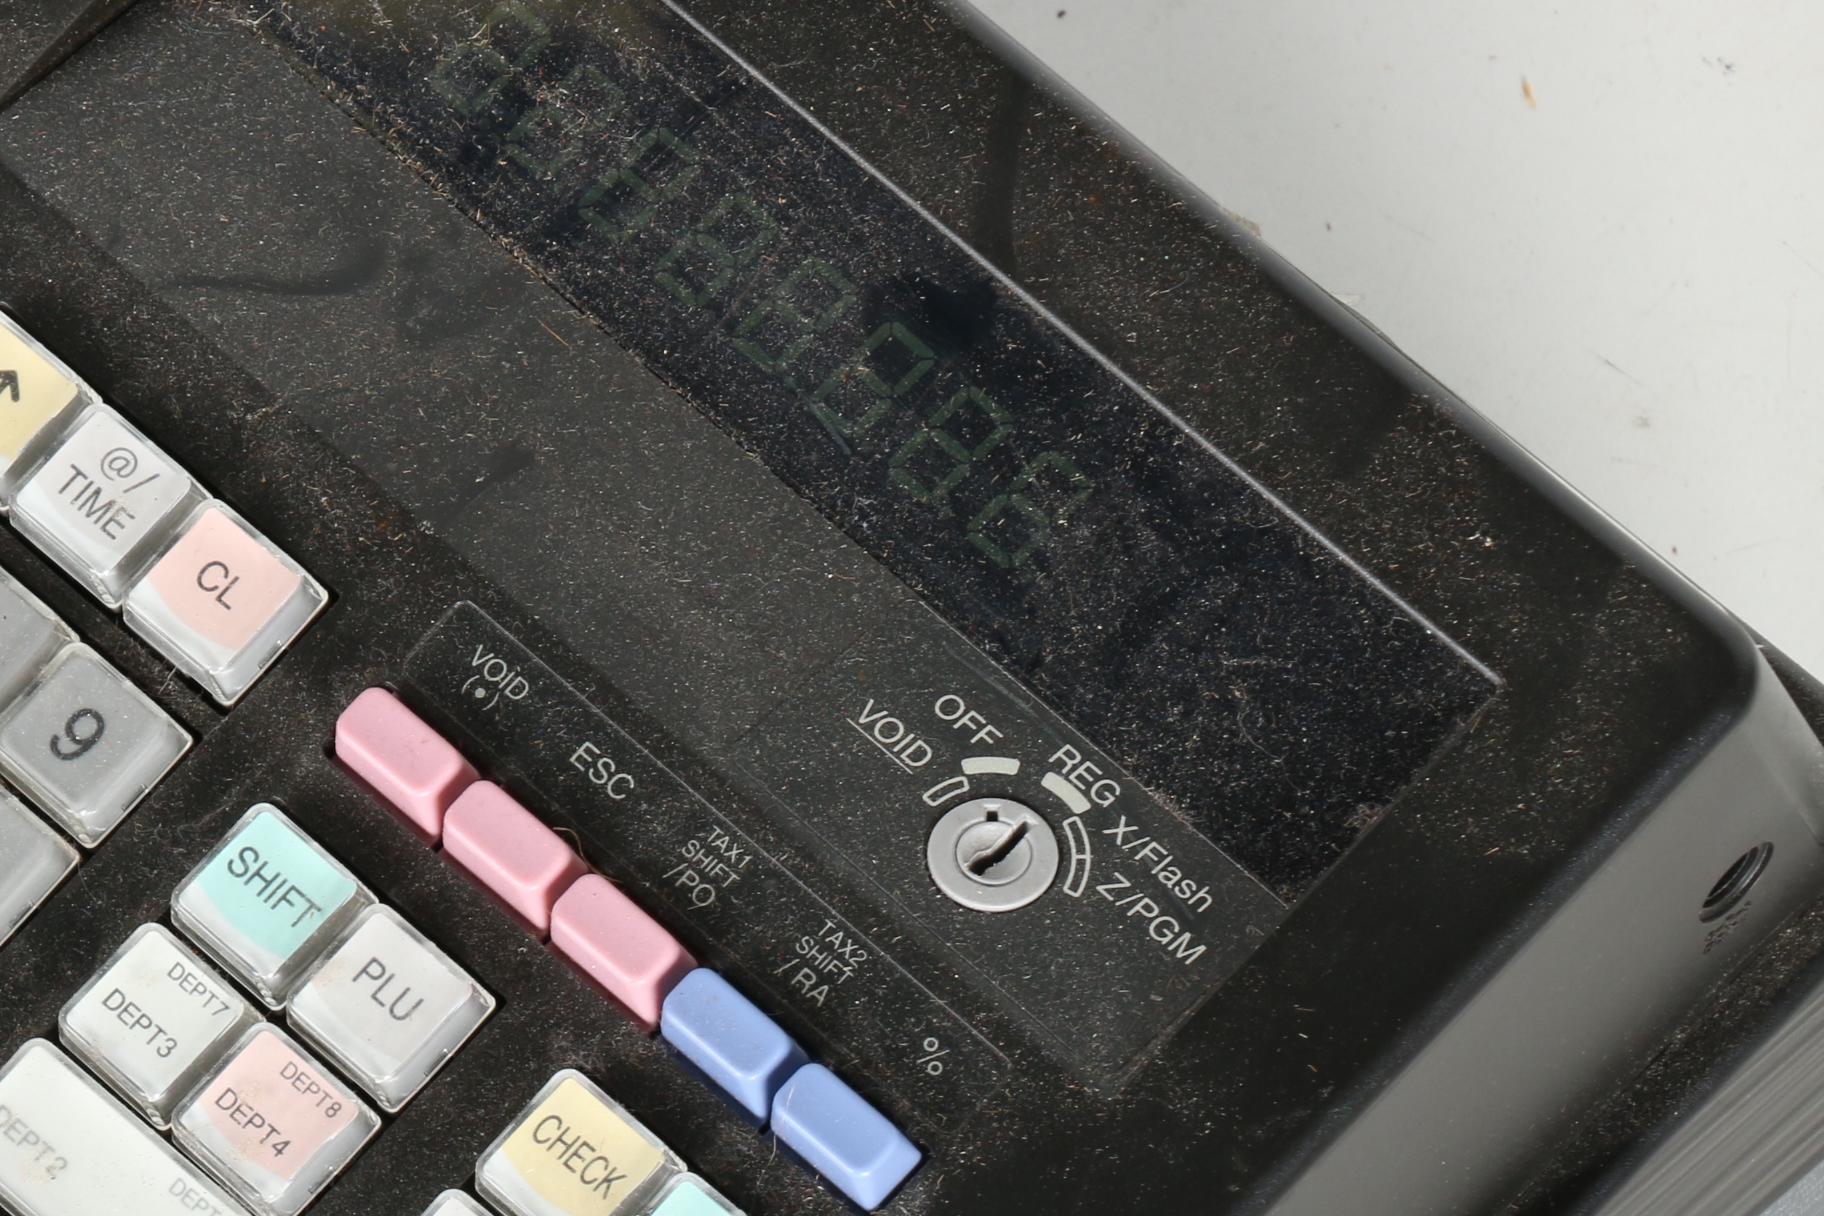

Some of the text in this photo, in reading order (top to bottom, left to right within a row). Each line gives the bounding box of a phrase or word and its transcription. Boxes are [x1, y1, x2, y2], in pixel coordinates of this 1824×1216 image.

[56, 464, 136, 541] TIME
[195, 560, 246, 612] CL
[469, 643, 530, 702] VOID
[49, 707, 106, 762] 9
[857, 698, 933, 771] VOID
[934, 692, 1003, 746] OFF
[569, 741, 636, 801] ESC
[1047, 742, 1121, 808] REG
[681, 838, 740, 892] SHIFT
[706, 824, 754, 867] TAX1
[1103, 815, 1214, 915] X/Flash
[226, 845, 324, 930] SHIFT
[816, 918, 869, 966] TAX2
[1096, 873, 1208, 966] Z/PGM
[166, 961, 231, 1018] DEPT7
[351, 956, 426, 1023] PLU
[795, 934, 854, 985] SHIFT
[100, 987, 179, 1060] DEPT3
[918, 1036, 949, 1077] %
[278, 1060, 344, 1120] DEPT8
[213, 1086, 293, 1160] DEPT4
[531, 1113, 629, 1202] CHECK
